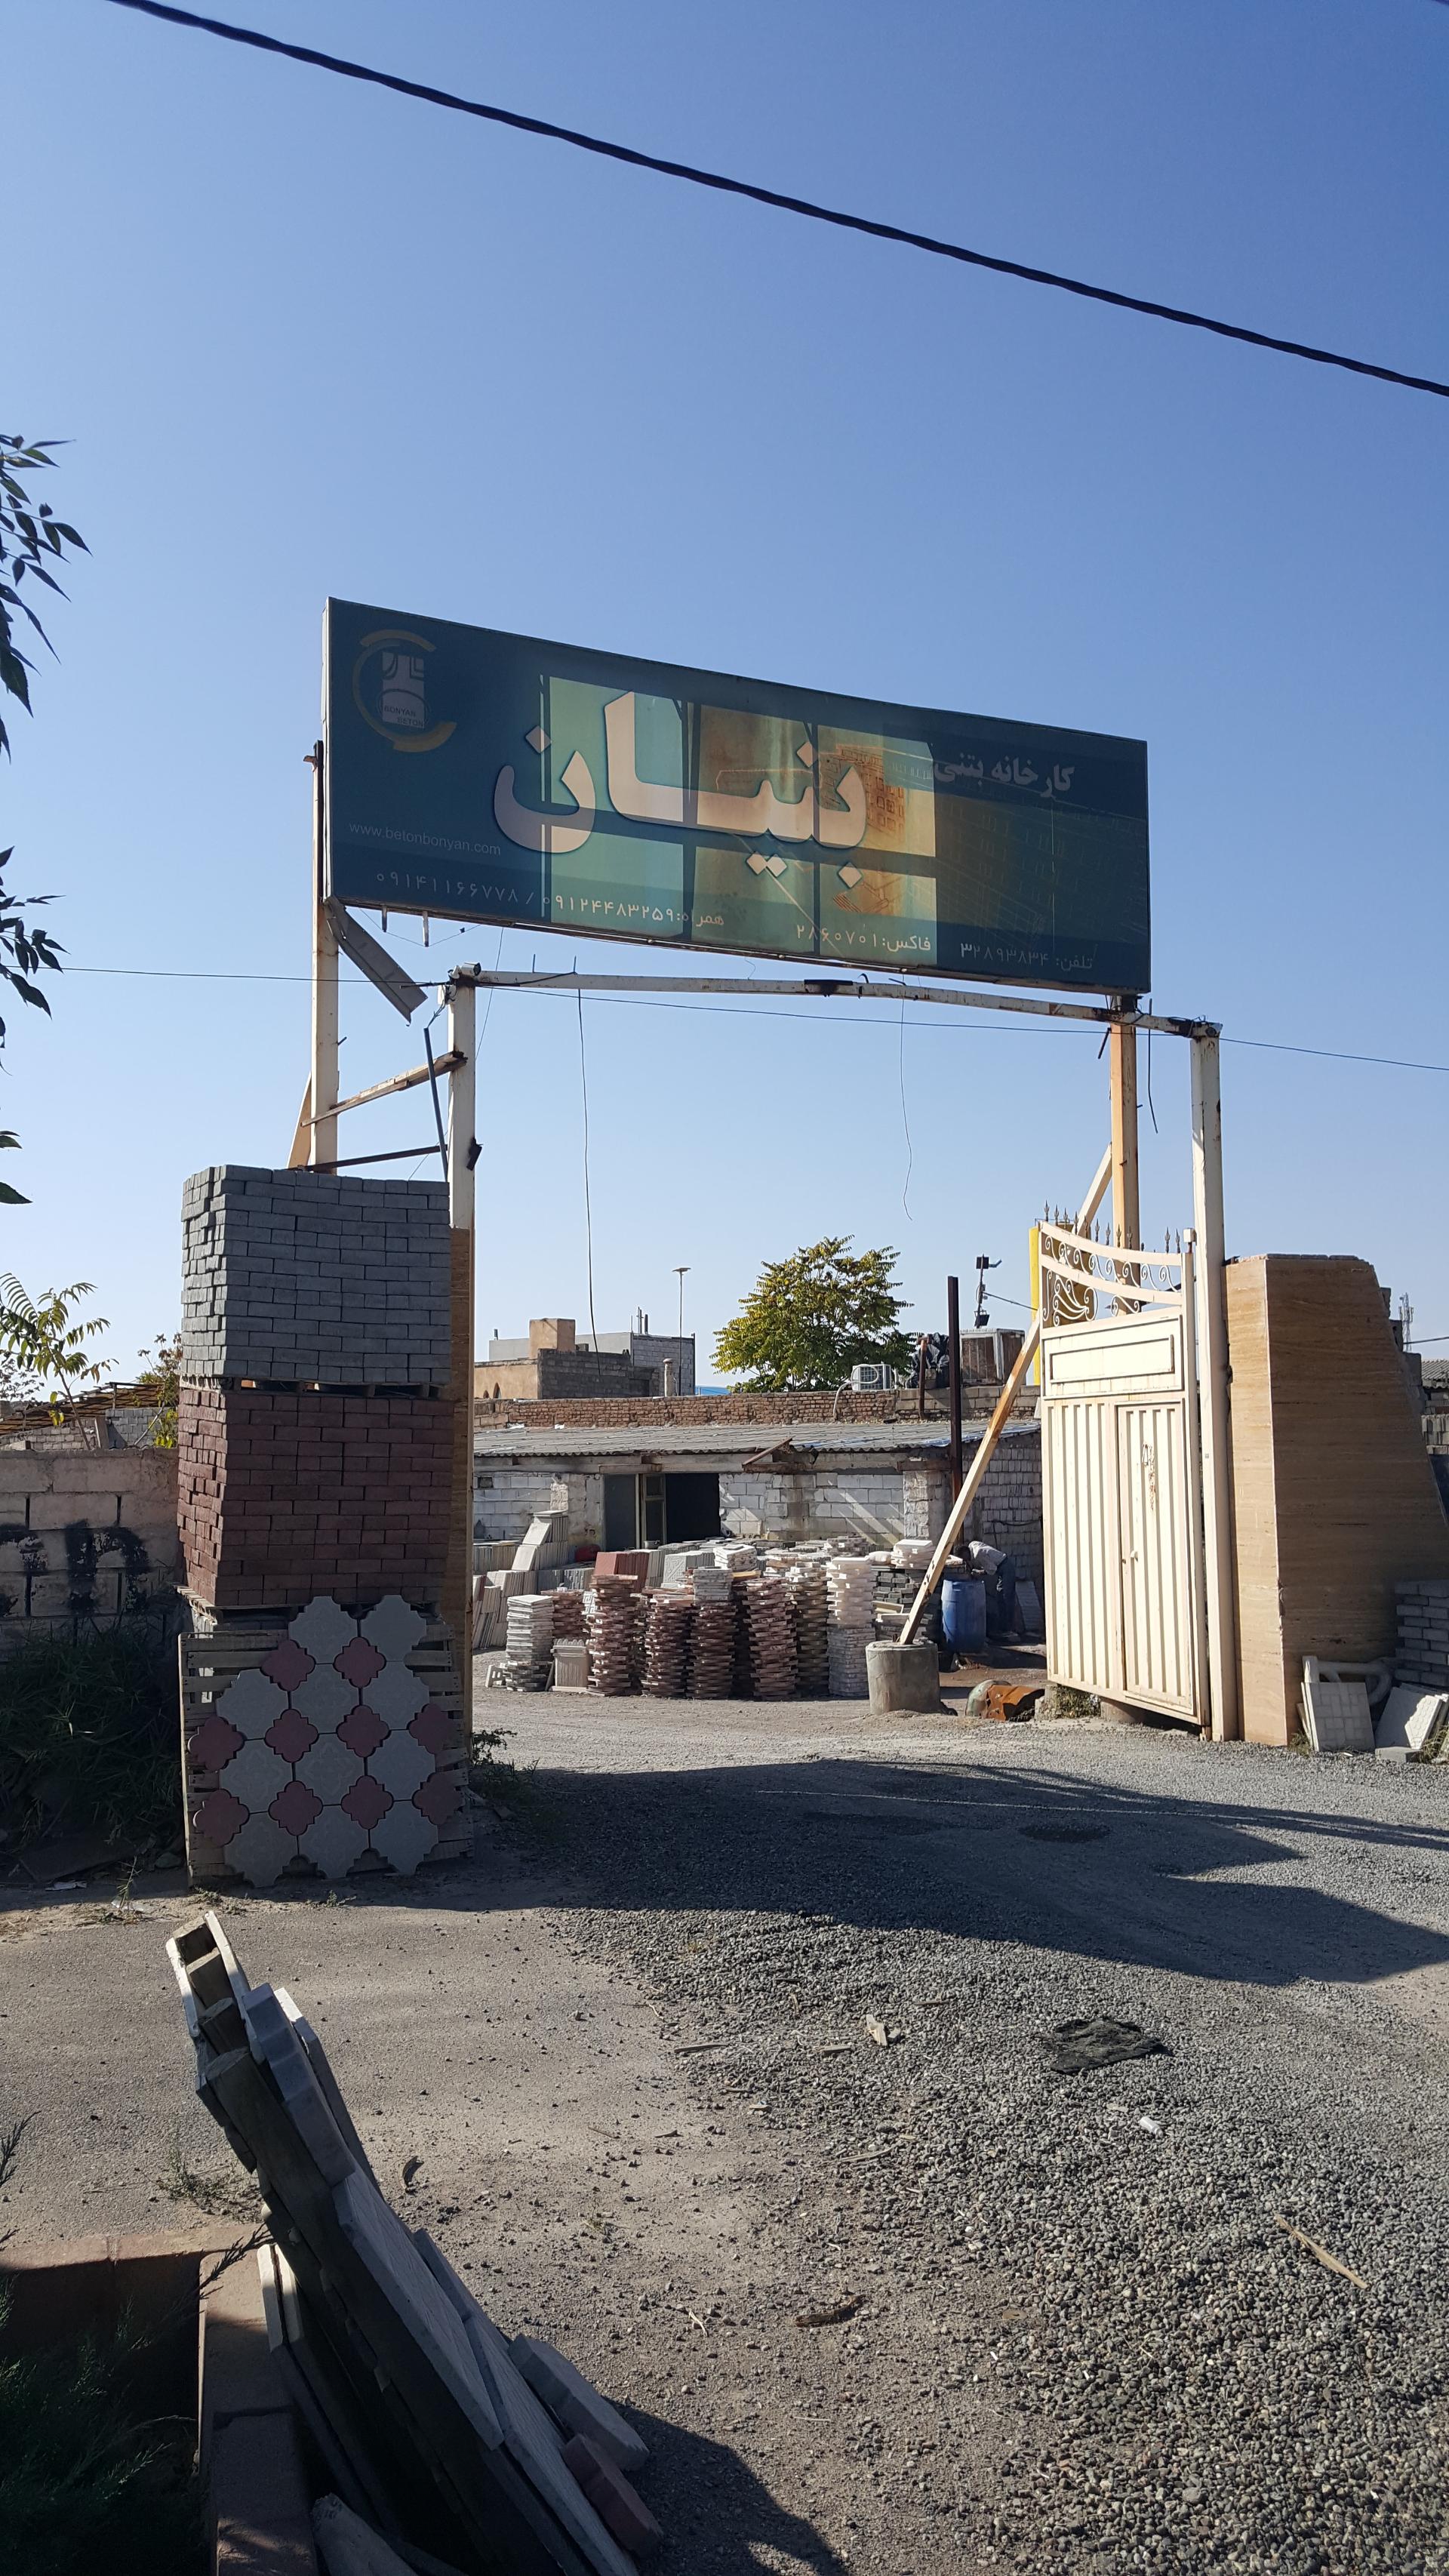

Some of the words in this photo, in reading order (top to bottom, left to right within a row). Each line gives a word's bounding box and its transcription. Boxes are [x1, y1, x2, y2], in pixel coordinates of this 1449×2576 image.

[383, 705, 416, 717] BONYAN
[397, 717, 429, 731] BETON
[934, 752, 984, 786] بتنی
[991, 755, 1075, 798] کارخانه
[494, 691, 867, 889] بنیان
[349, 823, 501, 855] www.betonbonyan.com
